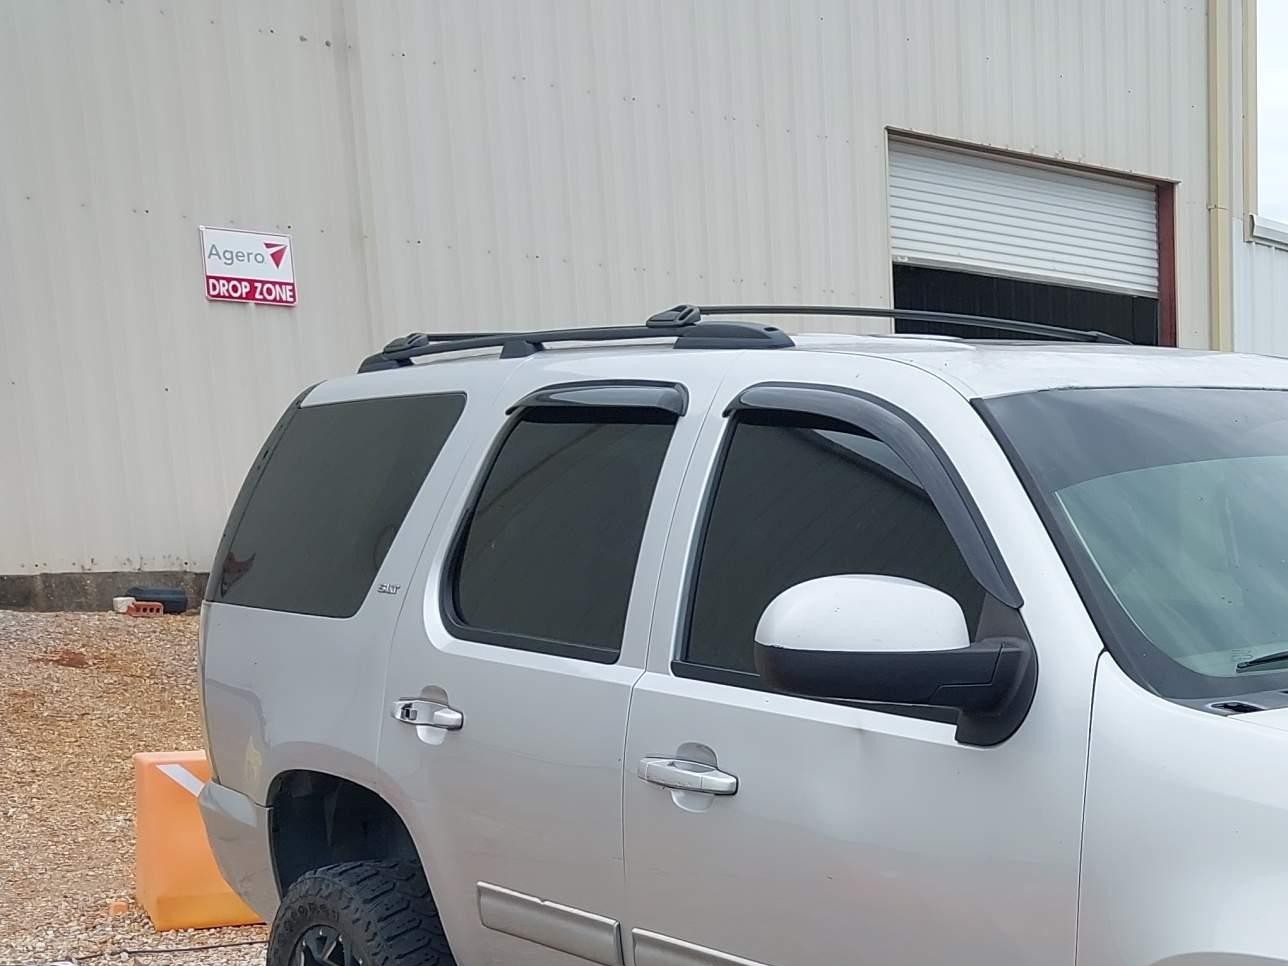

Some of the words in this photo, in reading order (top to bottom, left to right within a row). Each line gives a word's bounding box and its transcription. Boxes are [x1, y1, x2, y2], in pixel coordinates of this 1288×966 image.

[207, 243, 265, 266] Agero
[208, 279, 250, 298] DROP
[254, 282, 294, 302] ZONE
